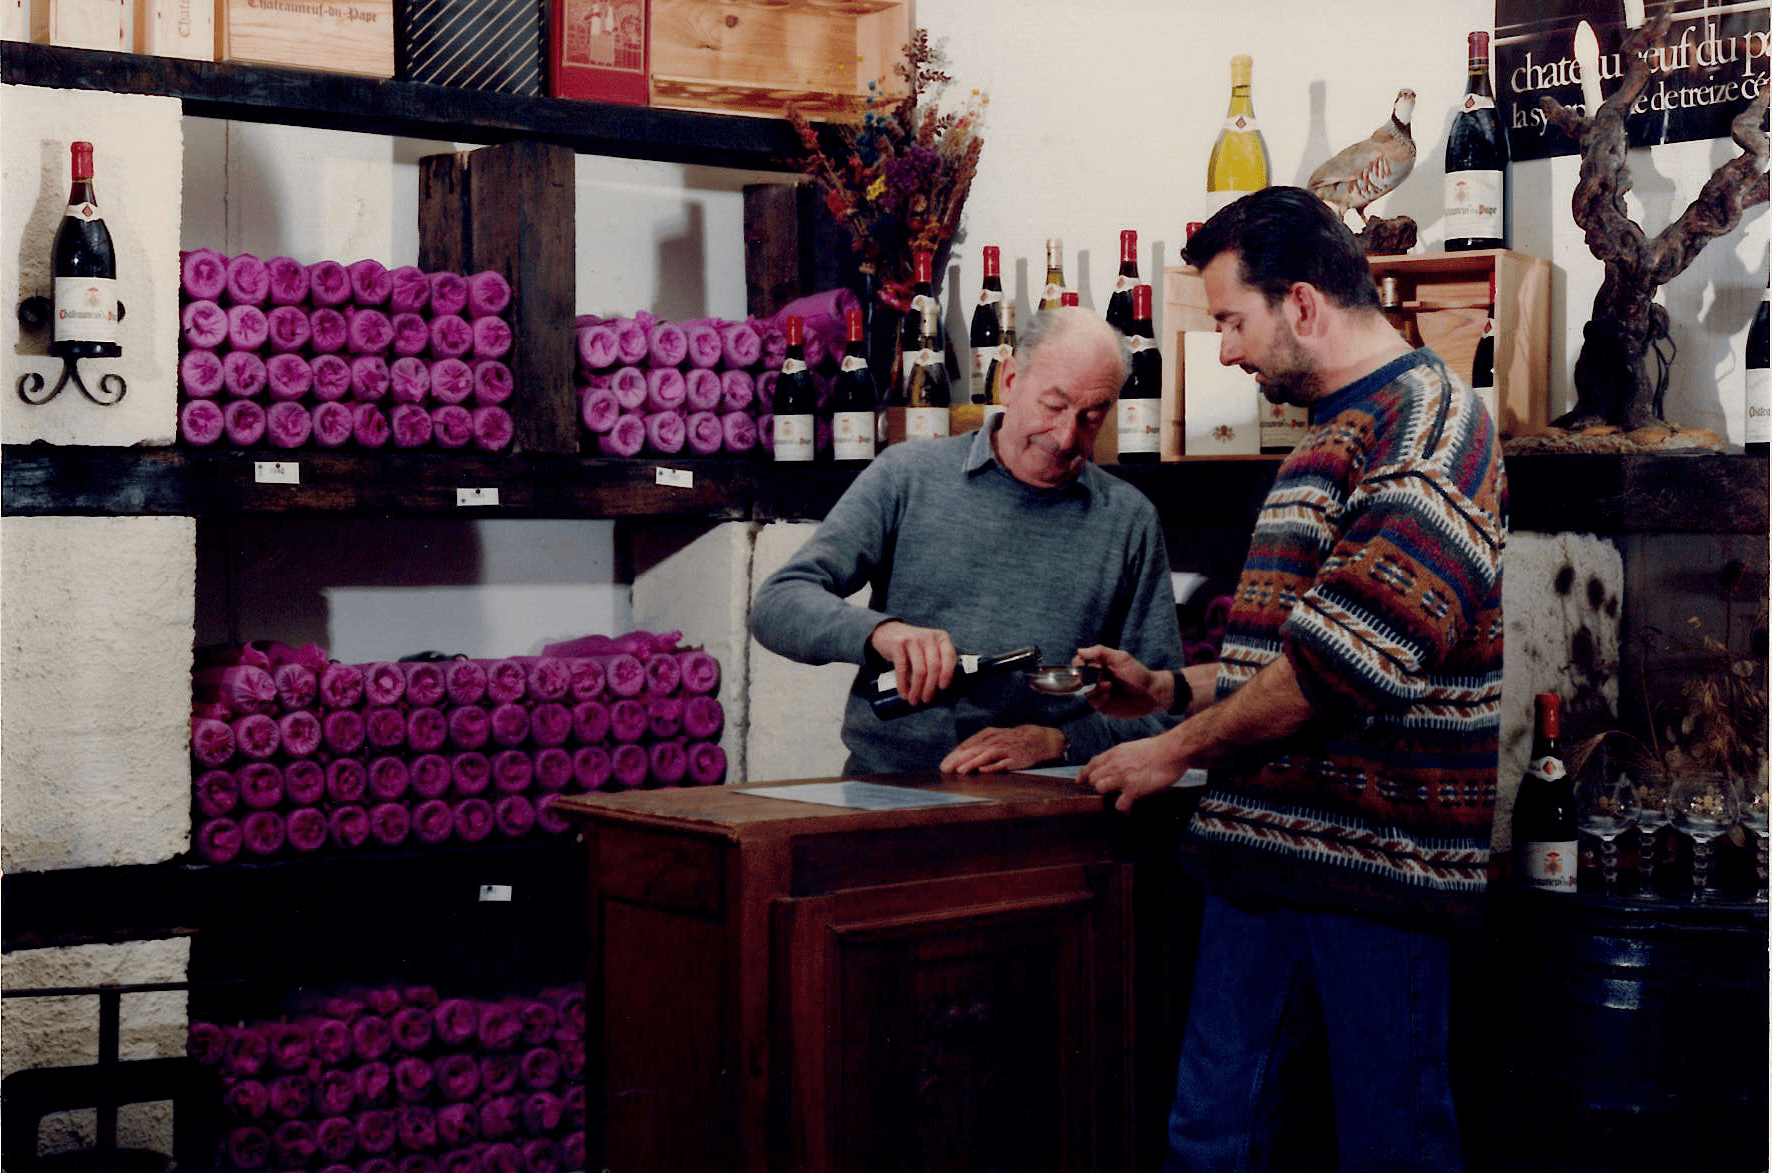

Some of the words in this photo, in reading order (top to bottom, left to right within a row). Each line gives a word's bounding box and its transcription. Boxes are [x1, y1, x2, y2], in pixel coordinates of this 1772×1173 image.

[1511, 25, 1697, 93] chateueuf
[1696, 22, 1739, 67] du
[1741, 31, 1770, 77] p
[1512, 101, 1528, 129] la
[1650, 81, 1679, 111] de
[1679, 74, 1739, 109] treize
